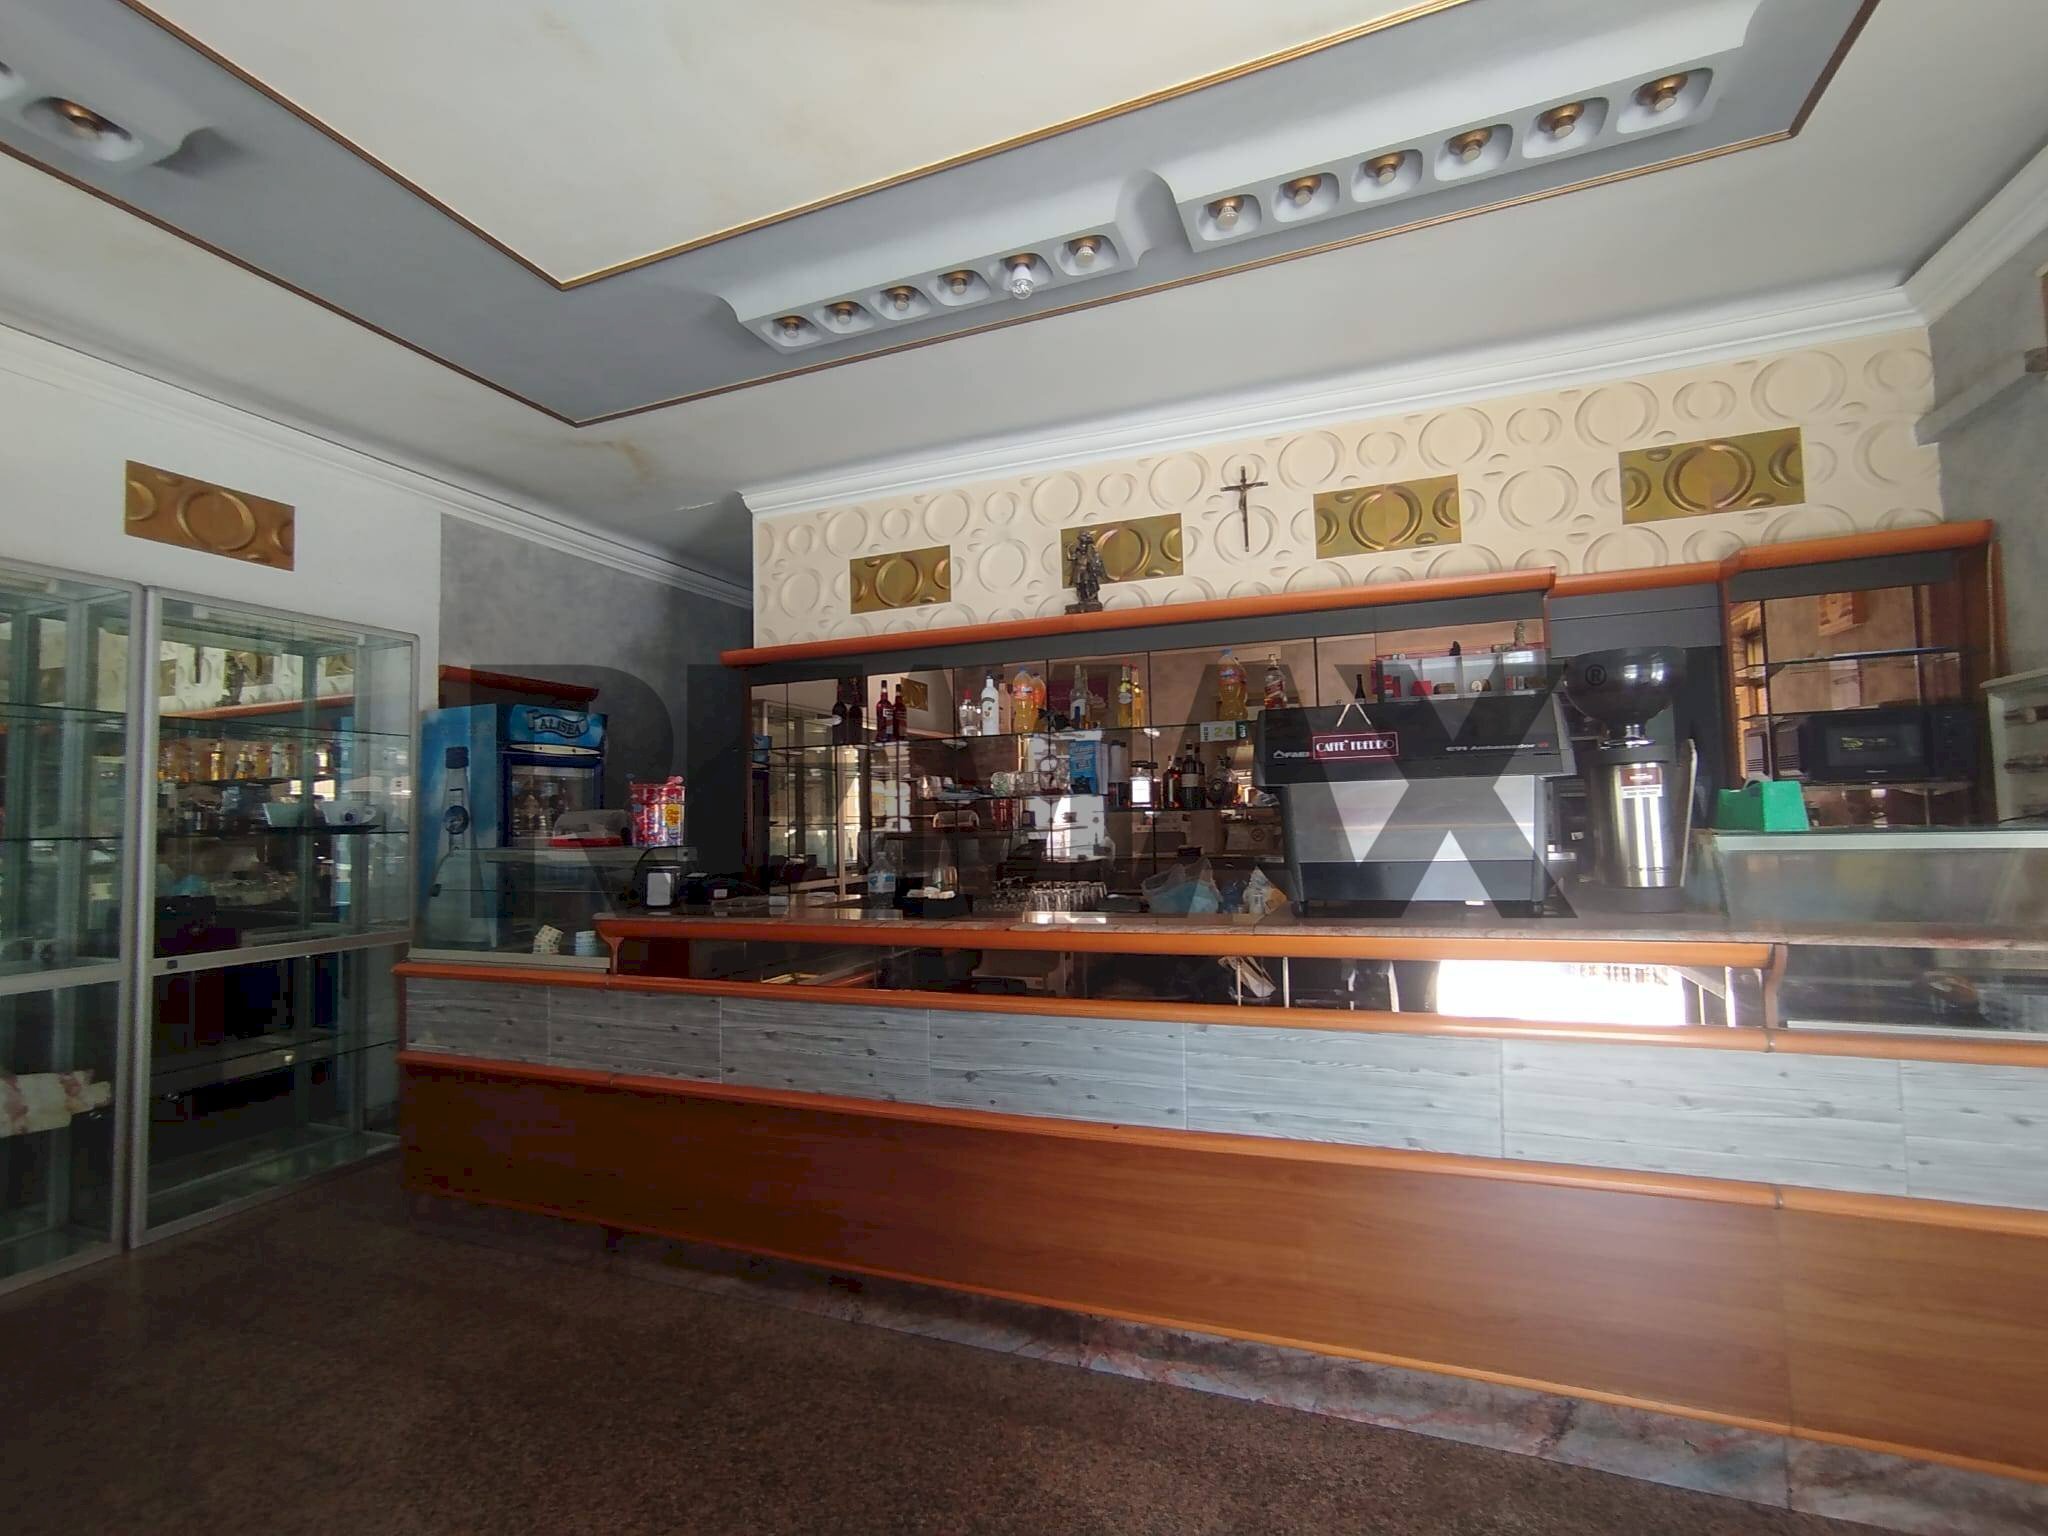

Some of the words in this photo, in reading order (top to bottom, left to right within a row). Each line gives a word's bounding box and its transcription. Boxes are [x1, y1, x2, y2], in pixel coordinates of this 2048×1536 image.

[539, 718, 582, 735] ALISEA
[1214, 726, 1234, 737] 24
[1350, 739, 1394, 751] FREDDO
